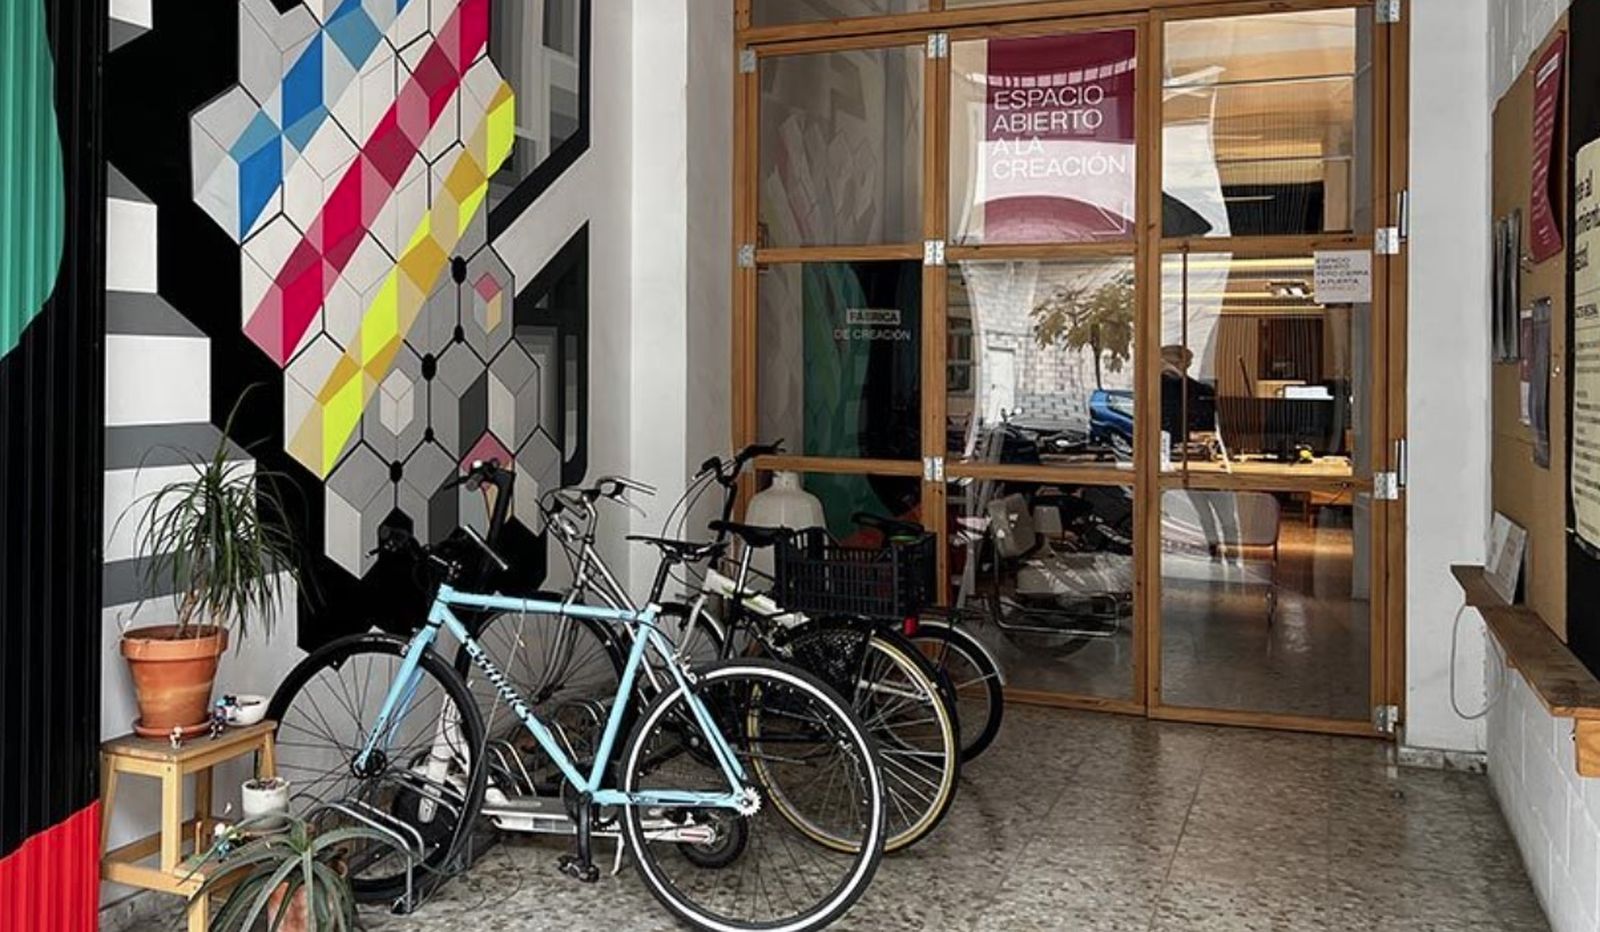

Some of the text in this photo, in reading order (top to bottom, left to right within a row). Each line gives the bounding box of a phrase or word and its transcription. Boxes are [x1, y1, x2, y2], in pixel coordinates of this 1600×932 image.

[993, 85, 1104, 111] ESPACIO
[992, 109, 1103, 132] ABIERTO
[992, 136, 1045, 156] A LA
[992, 152, 1126, 180] CREACIÓN
[833, 329, 850, 340] DE
